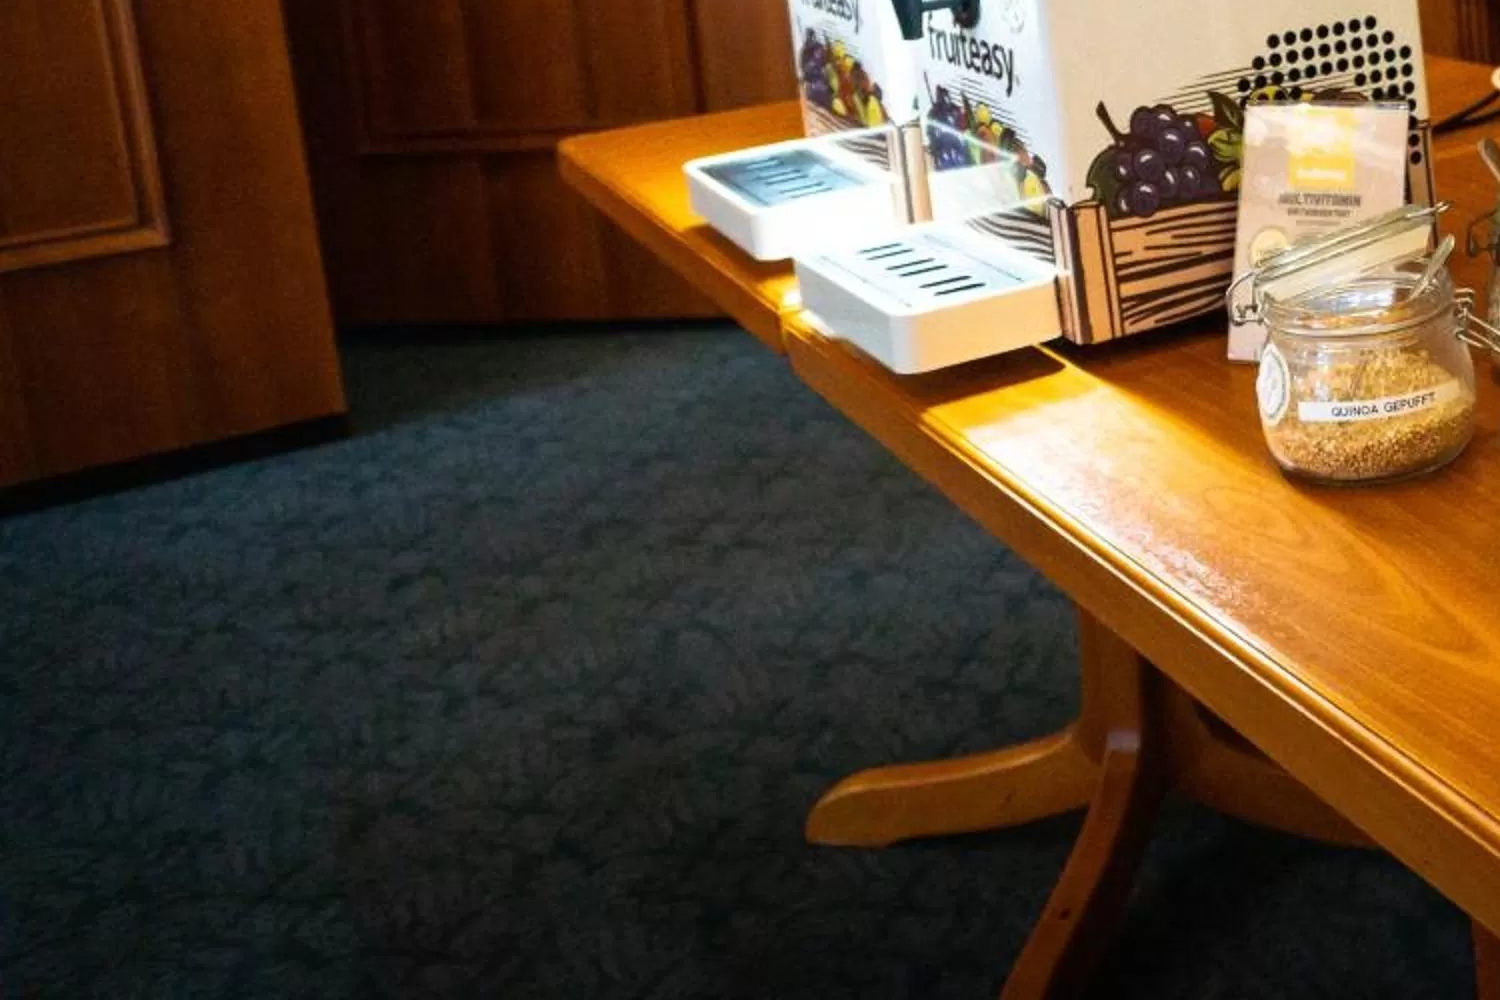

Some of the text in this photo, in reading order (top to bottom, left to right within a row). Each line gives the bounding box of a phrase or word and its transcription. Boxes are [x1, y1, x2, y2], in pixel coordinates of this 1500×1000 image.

[928, 13, 1014, 97] fruiteasy
[1331, 391, 1435, 418] QUINOA GEPUFFT
